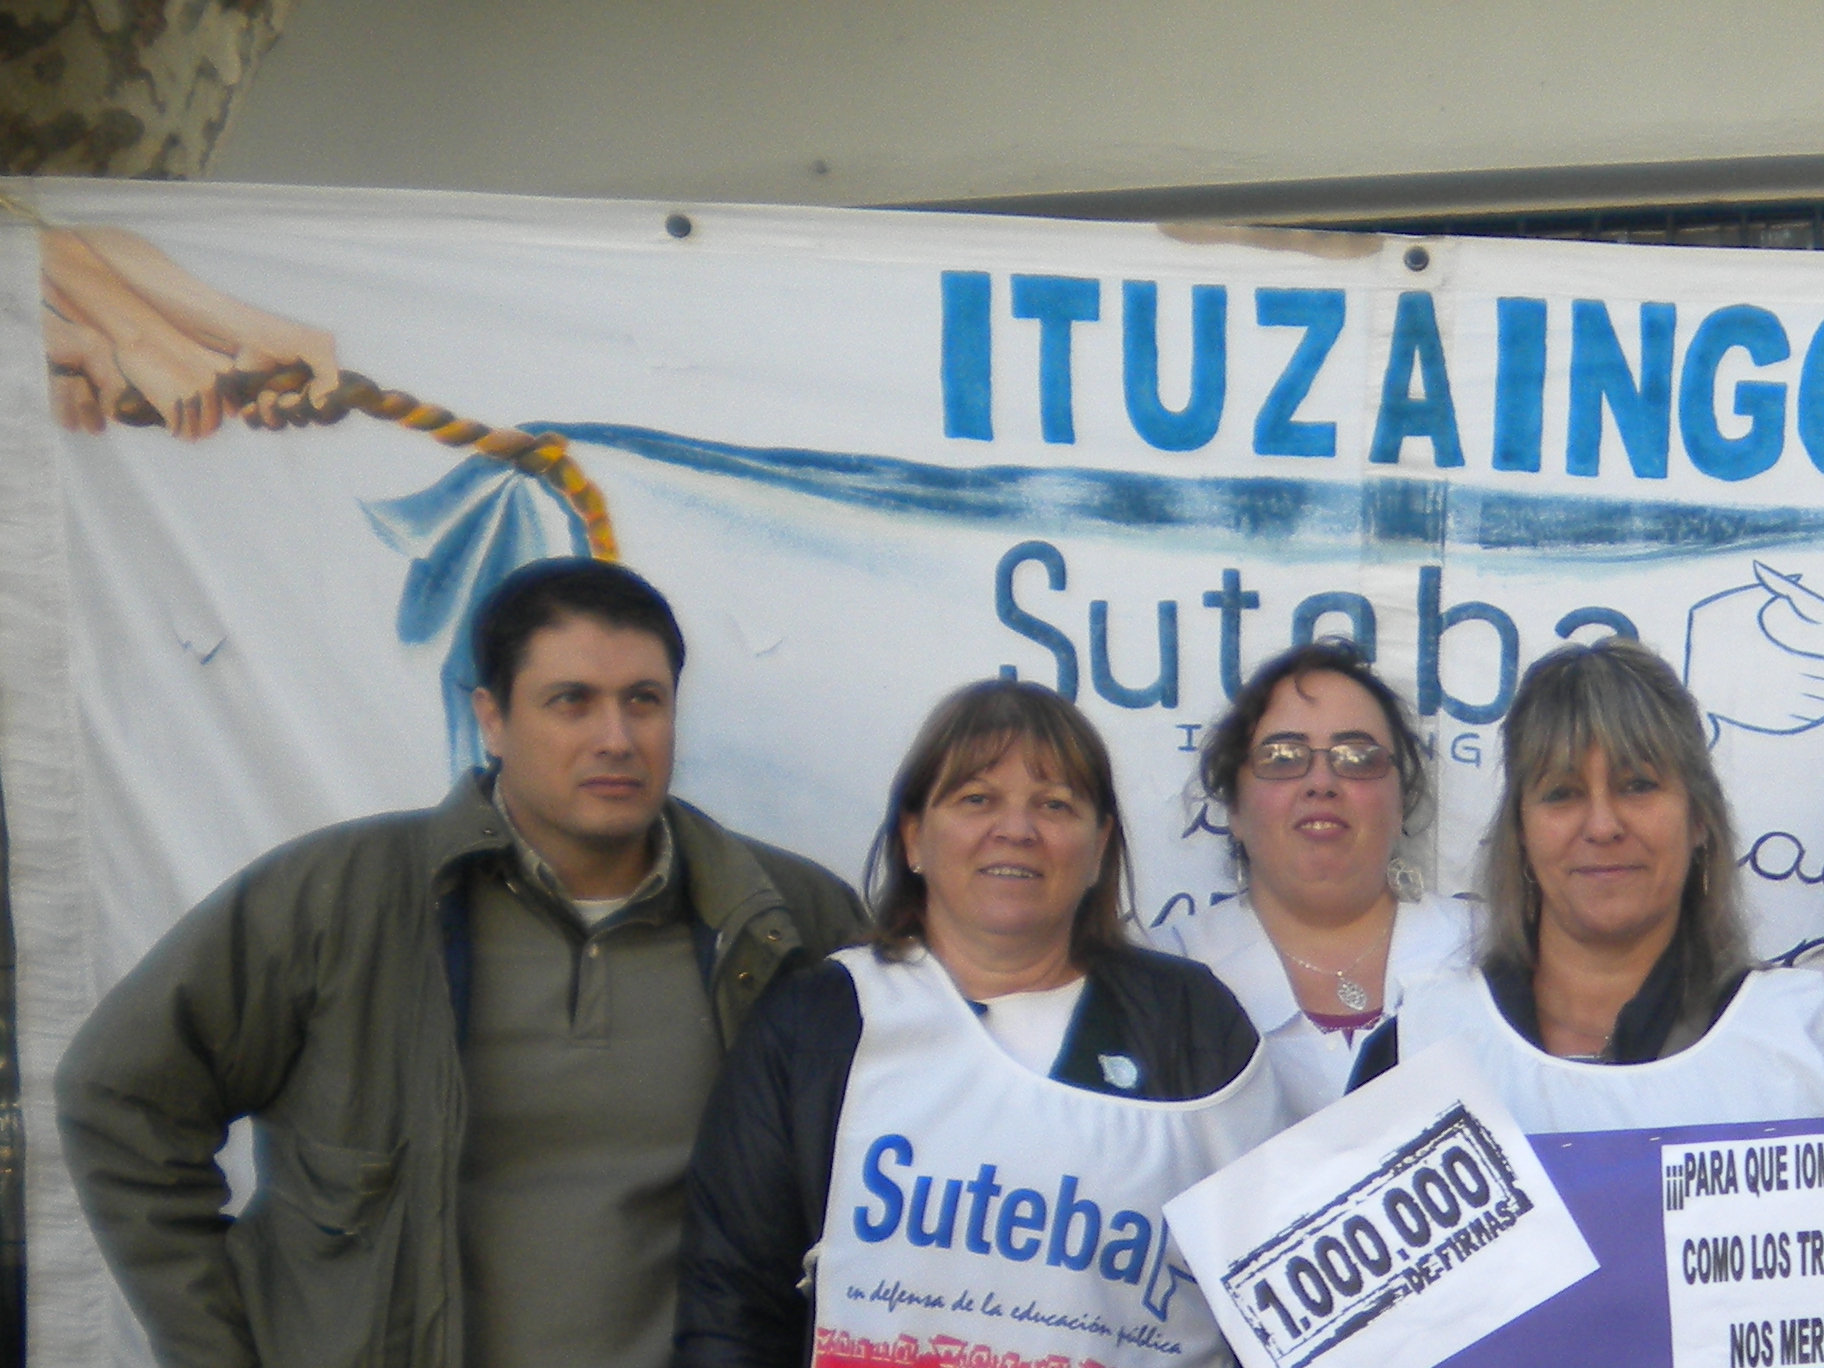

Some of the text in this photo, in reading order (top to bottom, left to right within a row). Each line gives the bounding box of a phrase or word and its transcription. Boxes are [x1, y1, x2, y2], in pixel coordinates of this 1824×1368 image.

[852, 1133, 1152, 1286] Suteba
[1744, 1145, 1790, 1199] QUE
[1252, 1145, 1492, 1341] 1.000.000
[1682, 1235, 1745, 1286] COMO
[1751, 1232, 1792, 1281] LOS
[846, 1278, 1182, 1357] en defensa de la educación pública
